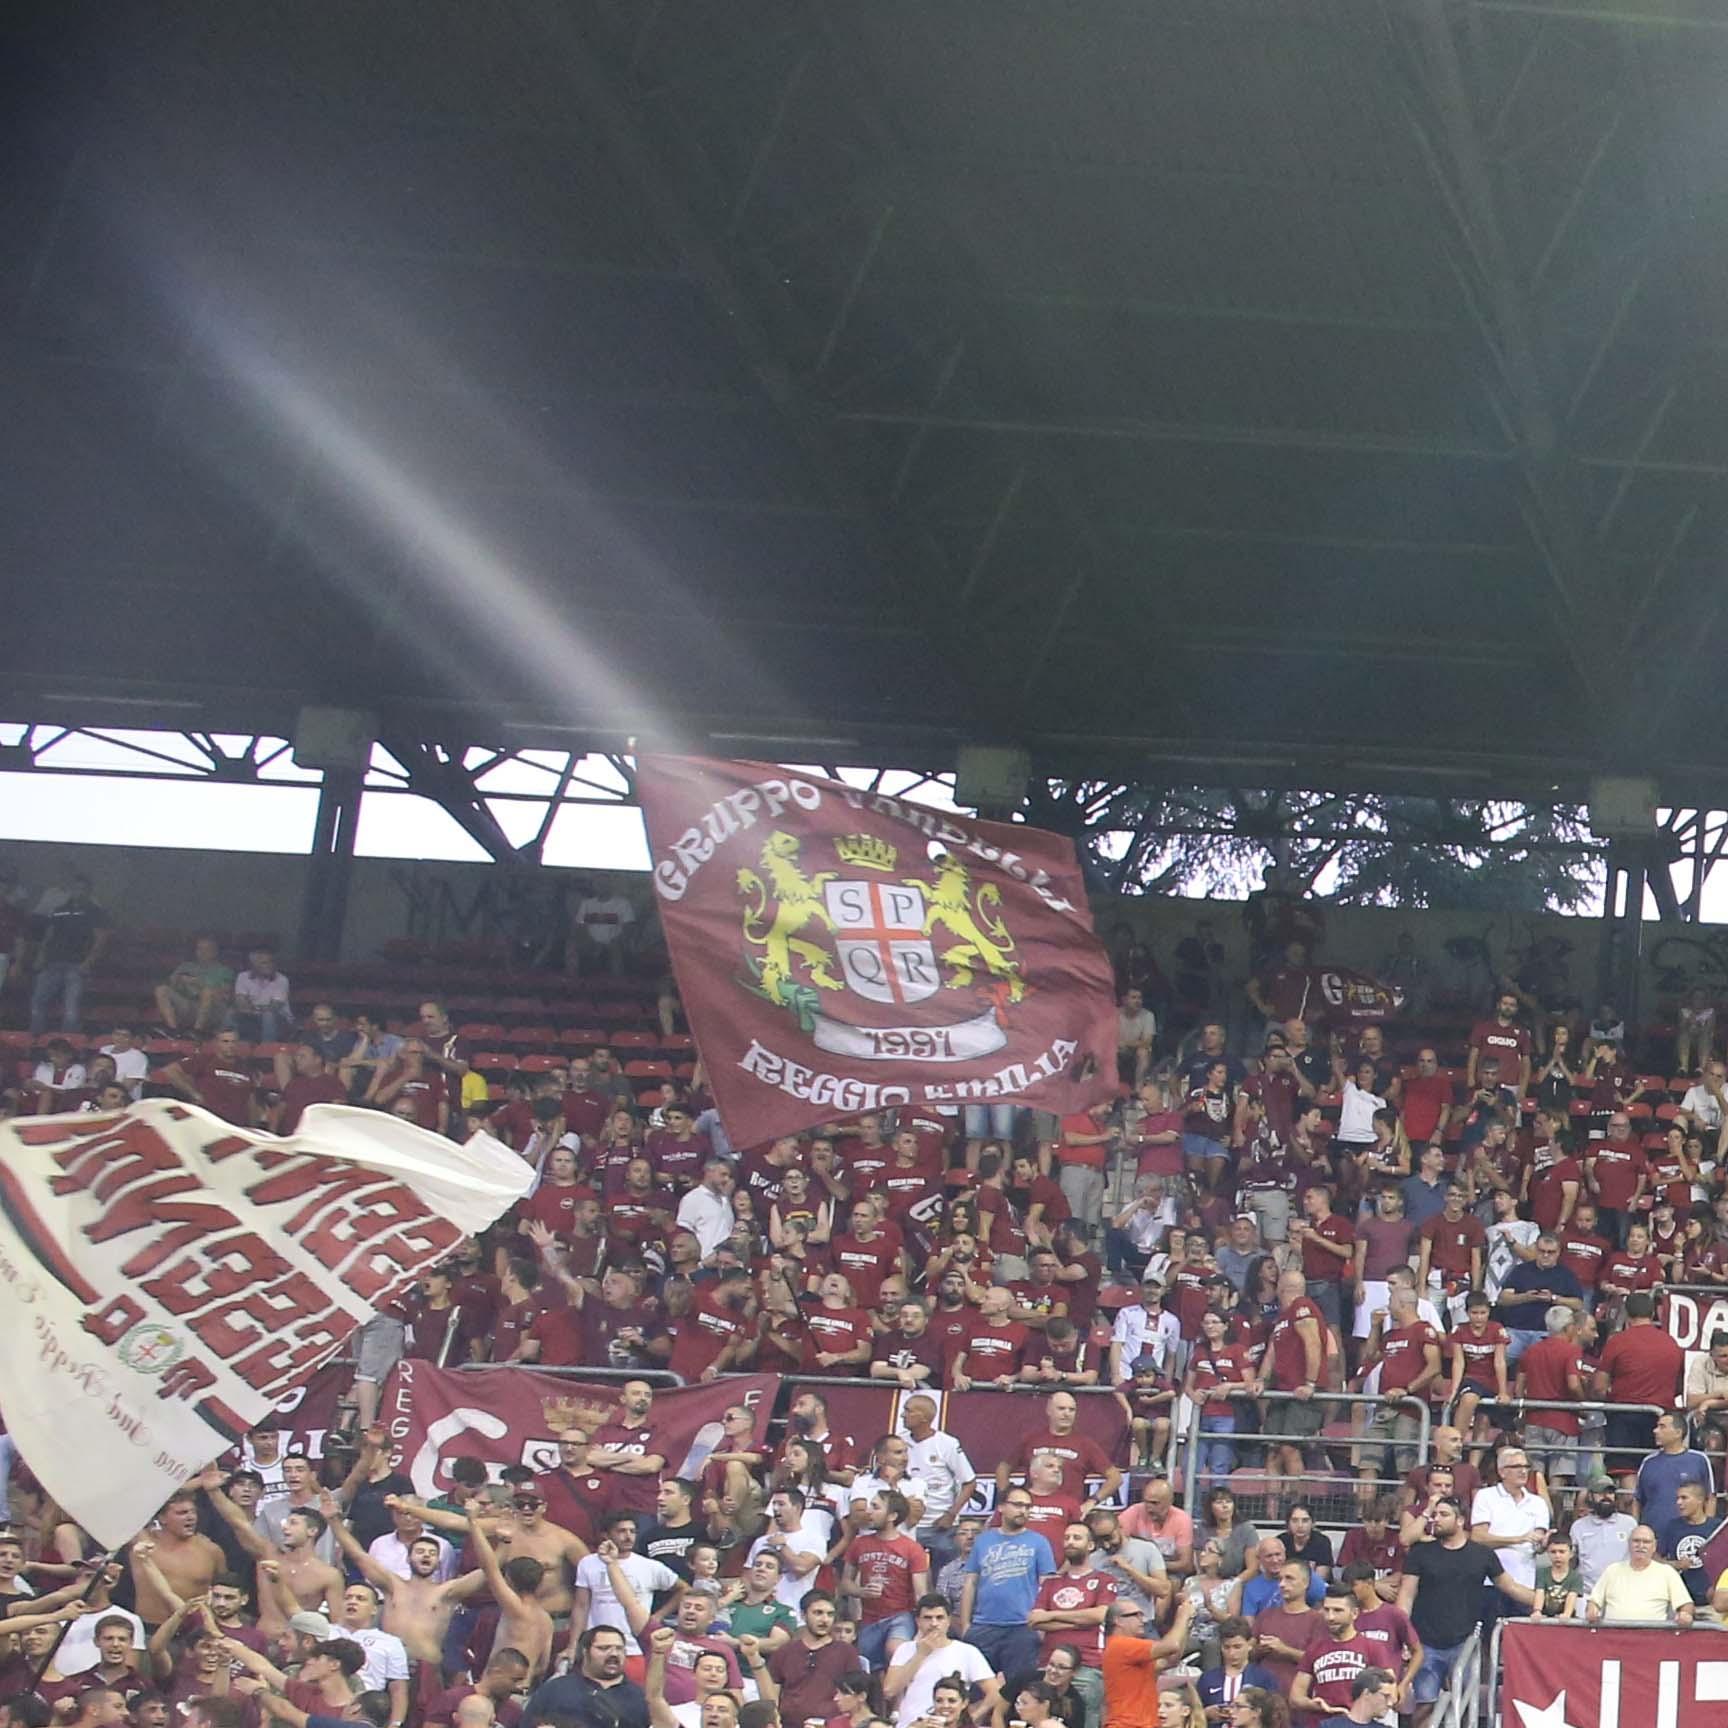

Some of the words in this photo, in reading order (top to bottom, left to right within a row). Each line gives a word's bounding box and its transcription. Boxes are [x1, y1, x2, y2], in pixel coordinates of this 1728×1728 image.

[652, 778, 822, 902] GRUPPO
[737, 1039, 910, 1111] REGGIO
[926, 1038, 1080, 1101] EMILIA
[871, 1028, 952, 1058] 1991
